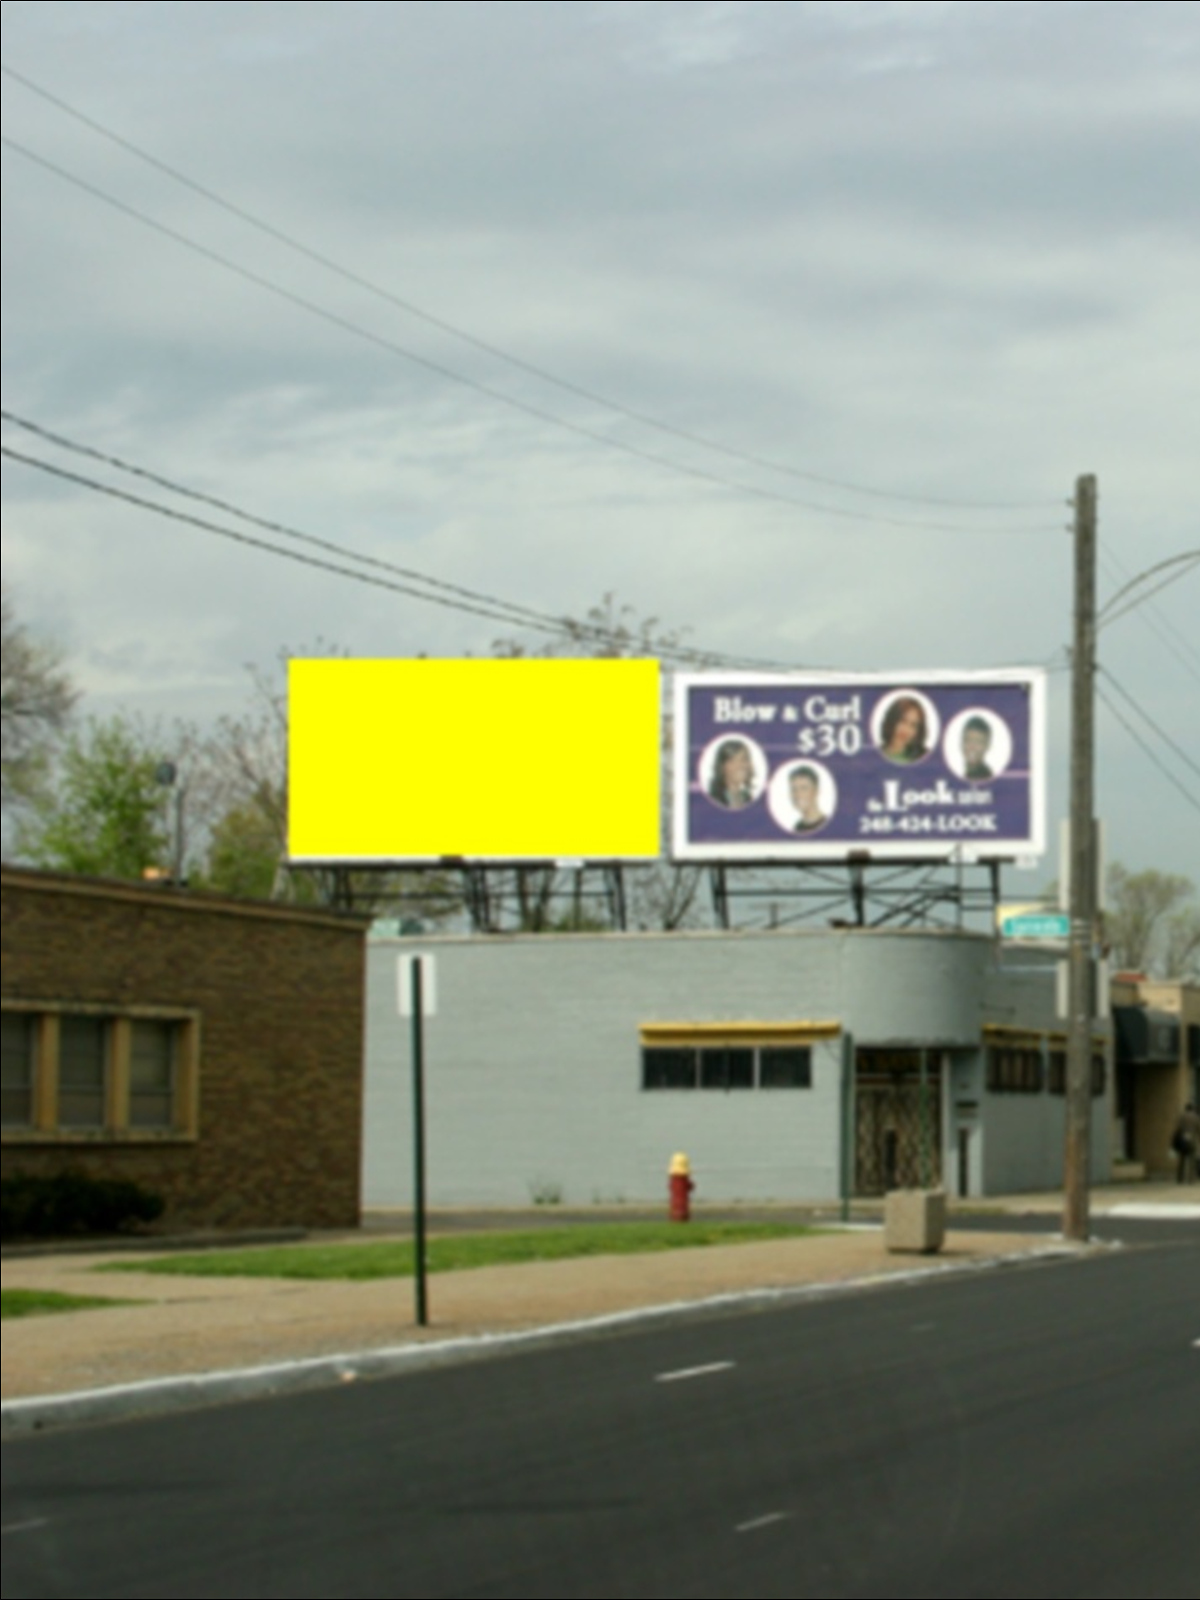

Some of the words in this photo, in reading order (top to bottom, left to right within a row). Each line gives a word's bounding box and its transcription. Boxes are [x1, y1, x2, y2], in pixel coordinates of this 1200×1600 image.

[713, 696, 776, 723] Blow
[803, 695, 861, 723] Curl
[798, 723, 861, 756] $30
[883, 779, 954, 812] Look
